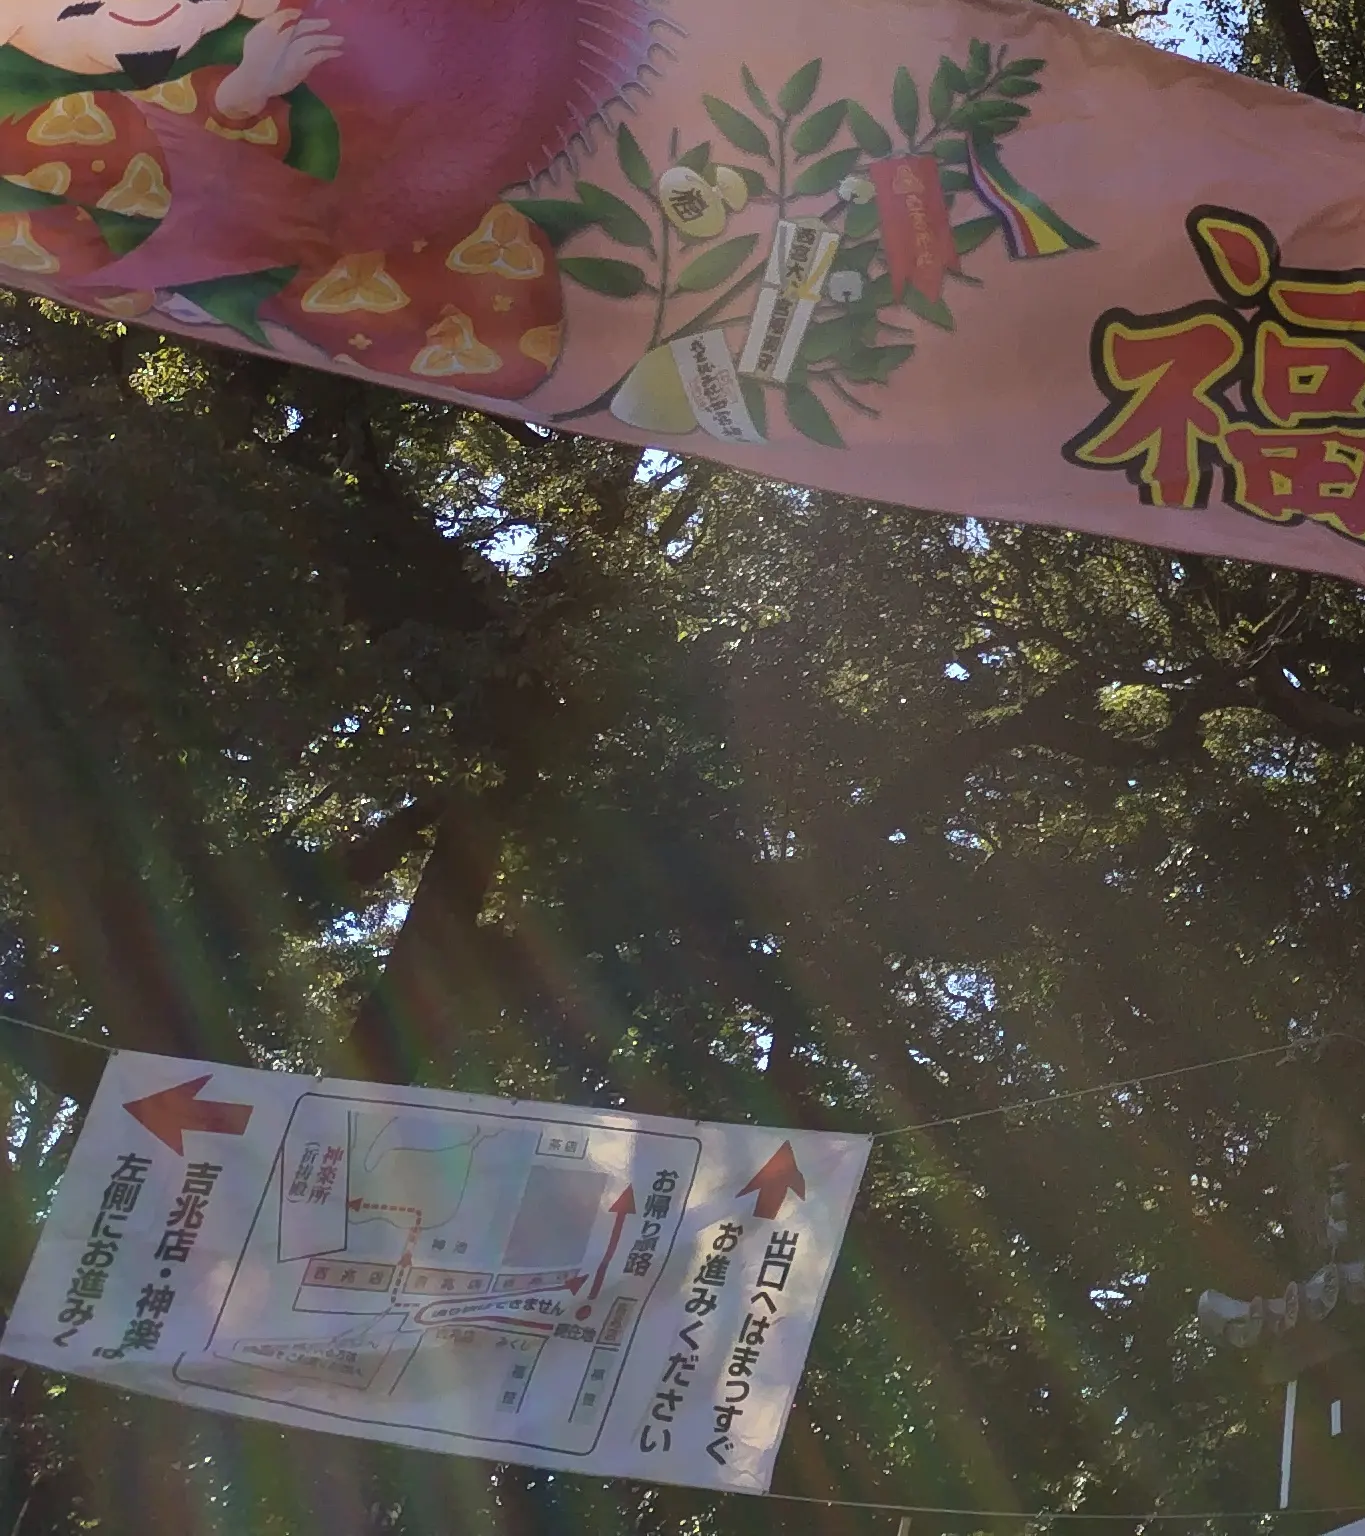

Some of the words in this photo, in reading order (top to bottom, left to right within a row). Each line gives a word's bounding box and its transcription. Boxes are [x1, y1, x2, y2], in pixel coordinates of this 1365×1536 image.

[640, 1222, 743, 1452] お進みください
